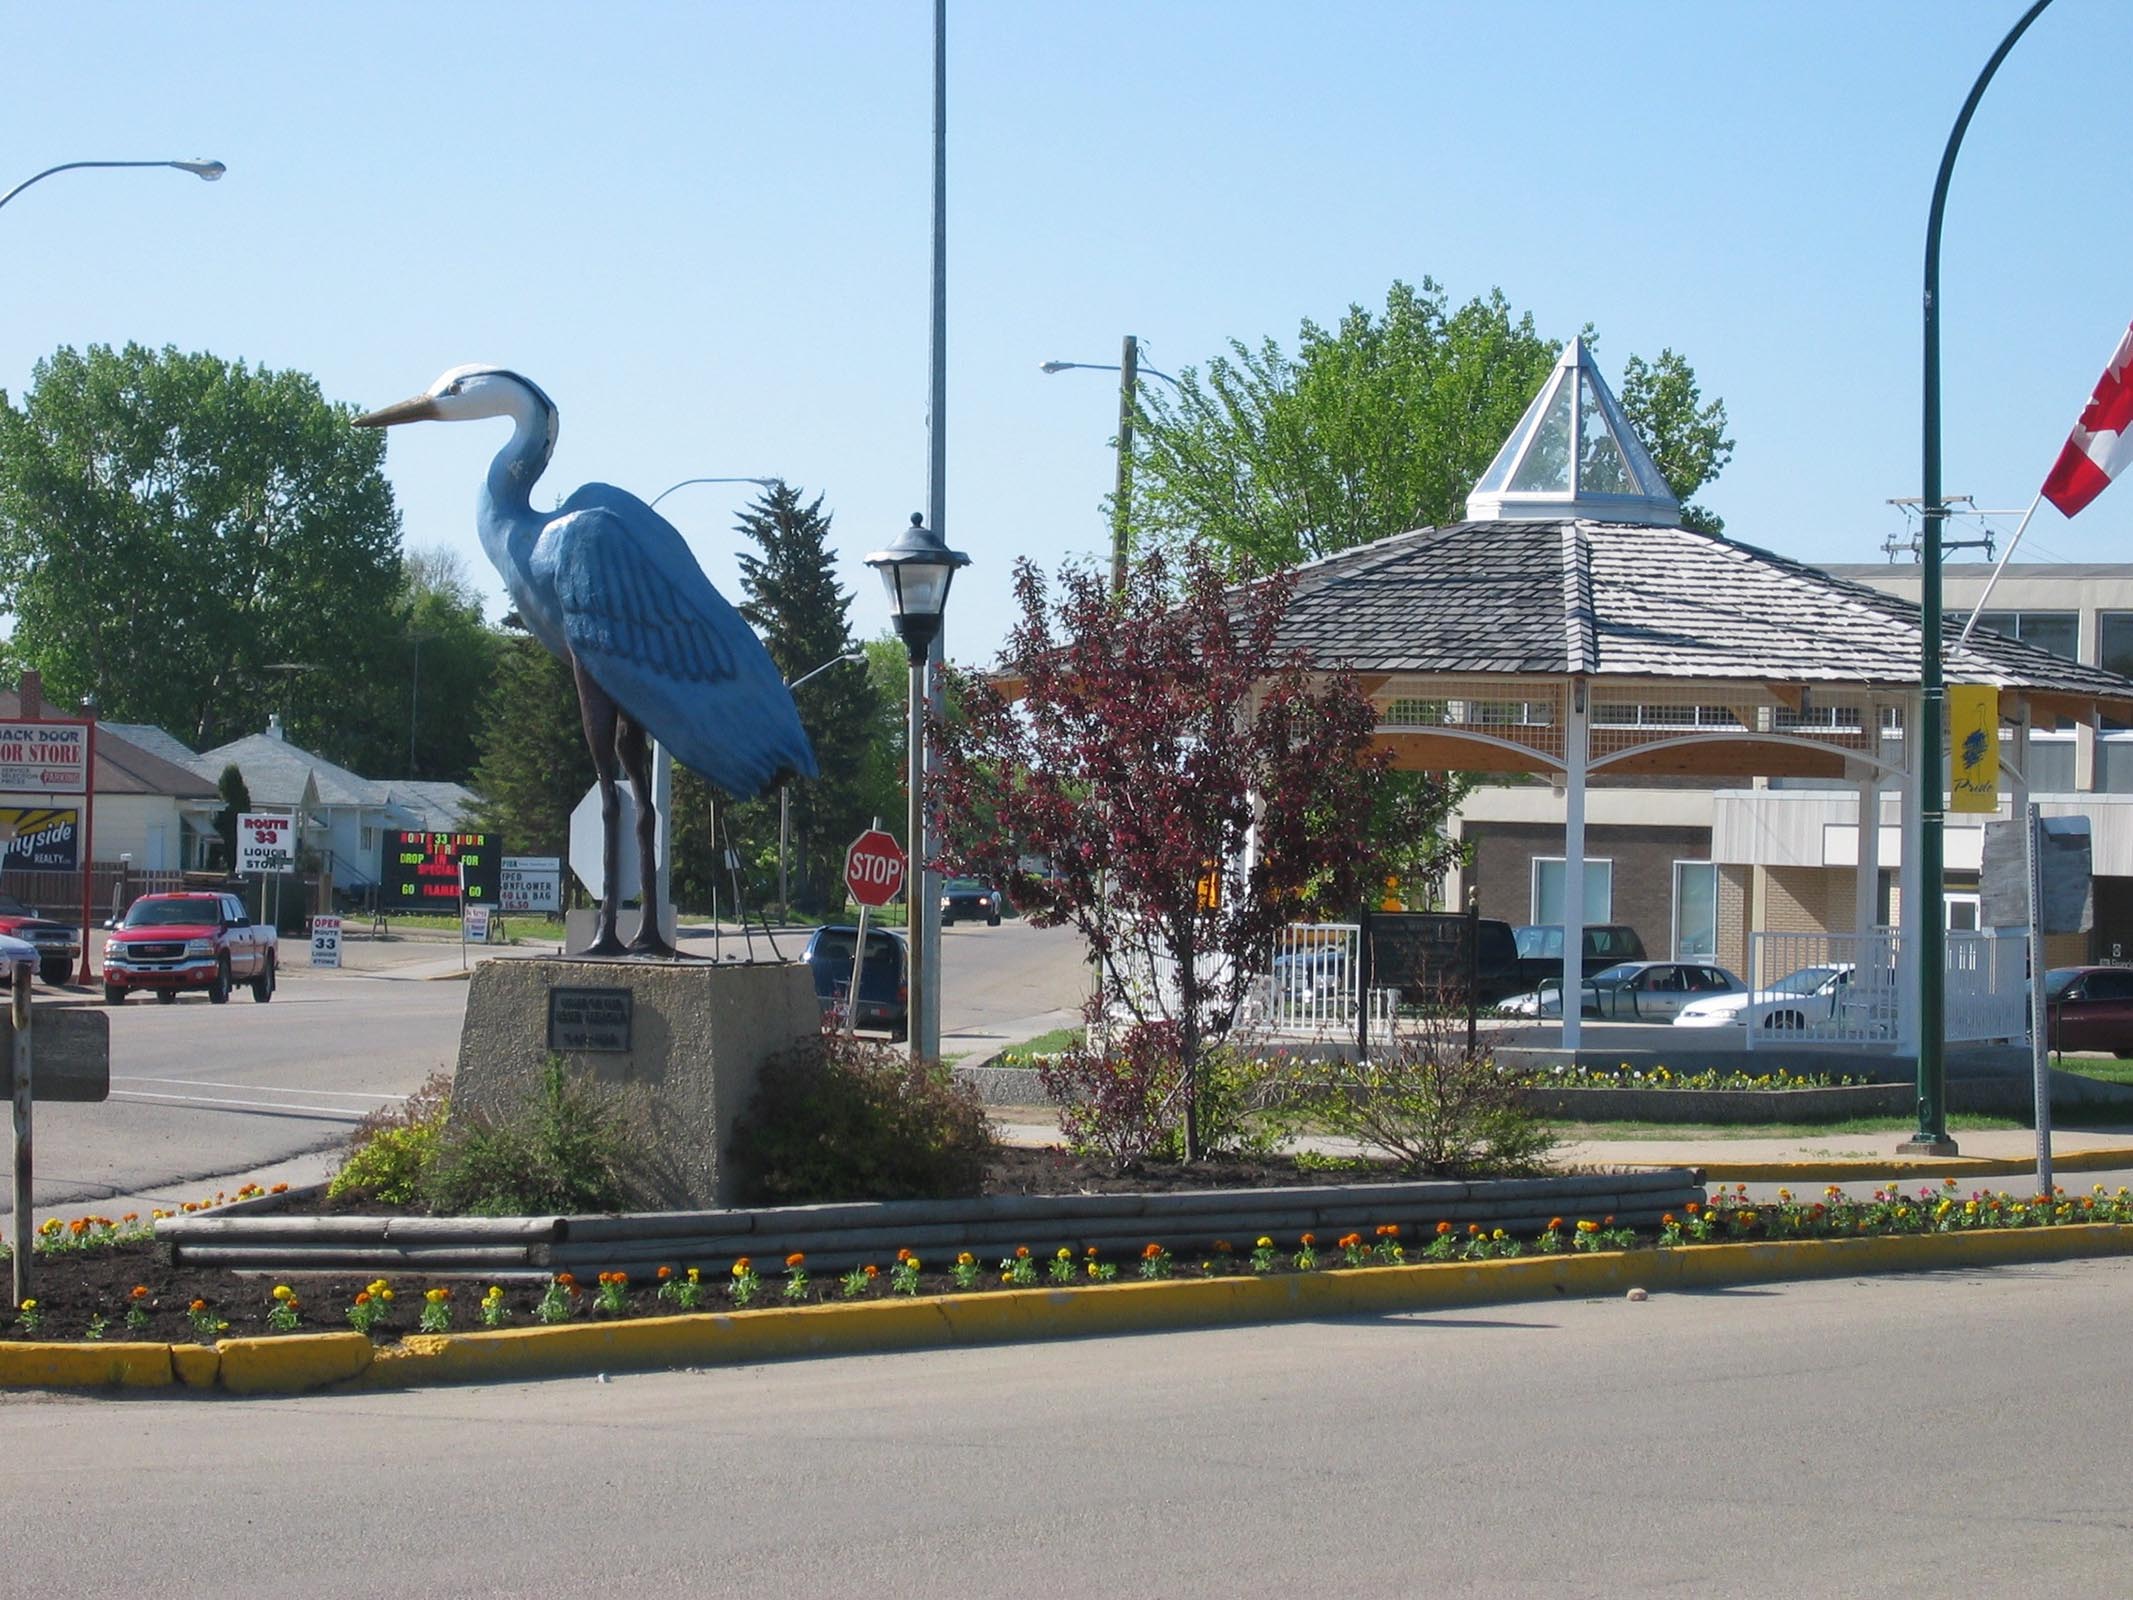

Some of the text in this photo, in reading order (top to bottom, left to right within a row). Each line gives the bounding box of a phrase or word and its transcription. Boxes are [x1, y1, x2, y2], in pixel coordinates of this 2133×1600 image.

[0, 730, 79, 742] ACK DOOR
[29, 744, 81, 763] STORE
[1953, 777, 1993, 793] Pride
[244, 818, 288, 830] ROUTE
[255, 831, 277, 844] 33
[400, 832, 434, 844] ROUTE
[434, 833, 448, 845] 33
[425, 844, 458, 855] STORE
[34, 853, 64, 864] REALTY
[400, 854, 425, 865] DROP
[461, 855, 479, 866] FOR
[851, 852, 899, 885] STOP
[401, 884, 415, 895] GO
[468, 886, 482, 897] GO
[500, 882, 552, 891] UNFLOWER
[516, 892, 528, 900] LB
[532, 892, 551, 901] BAG
[314, 919, 340, 928] OPEN
[315, 938, 336, 950] 33
